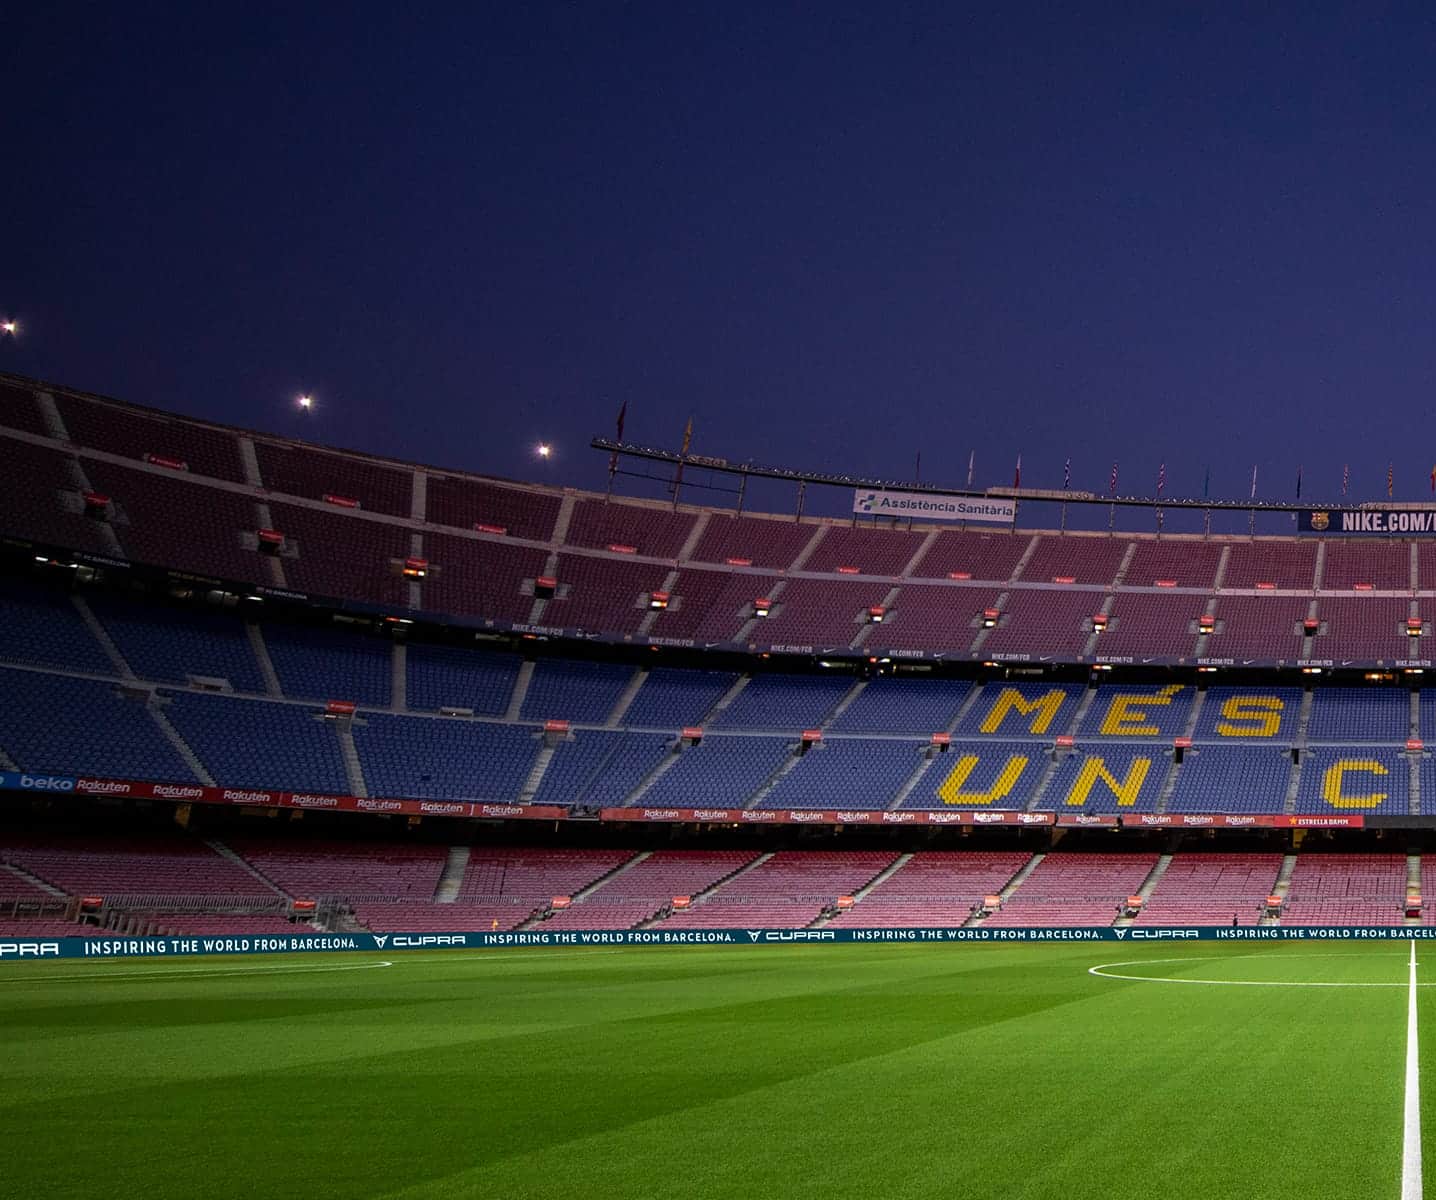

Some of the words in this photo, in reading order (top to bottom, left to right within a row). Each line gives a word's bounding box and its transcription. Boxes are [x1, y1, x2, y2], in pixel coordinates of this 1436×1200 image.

[880, 496, 955, 513] Assistència
[957, 500, 1014, 516] Sanitària
[980, 684, 1285, 738] MÉS
[20, 775, 73, 791] beko
[939, 755, 1151, 806] UN
[77, 780, 131, 793] Rakuten
[153, 785, 203, 798] Rakuten
[224, 790, 271, 803] Rakuten
[291, 795, 337, 807] Rakuten
[357, 799, 402, 811] Rakuten
[421, 802, 464, 814] Rakuten
[482, 805, 523, 816] Rakuten
[644, 810, 679, 819] Rakuten
[694, 810, 728, 819] Rakuten
[742, 811, 775, 820] Rakuten
[790, 811, 823, 821] Rakuten
[837, 811, 869, 821] Rakuten
[883, 812, 915, 821] Rakuten
[928, 813, 960, 822] Rakuten
[974, 813, 1004, 822] Rakuten
[1017, 813, 1048, 823] Rakuten
[1142, 815, 1171, 824] Rakuten
[1184, 816, 1213, 825] Rakuten
[1226, 816, 1255, 825] Rakuten
[485, 935, 548, 944] INSPIRING
[554, 934, 577, 942] THE
[582, 934, 623, 942] WORLD
[628, 933, 660, 942] FROM
[664, 933, 736, 941] BARCELONA.
[766, 932, 834, 940] CUPRA
[853, 931, 915, 939] INSPIRING
[393, 936, 465, 945] CUPRA
[85, 941, 166, 954] INSPIRING
[172, 941, 198, 952] THE
[204, 940, 249, 951] WORLD
[254, 939, 286, 950] FROM
[292, 938, 358, 949] BARCELONA.
